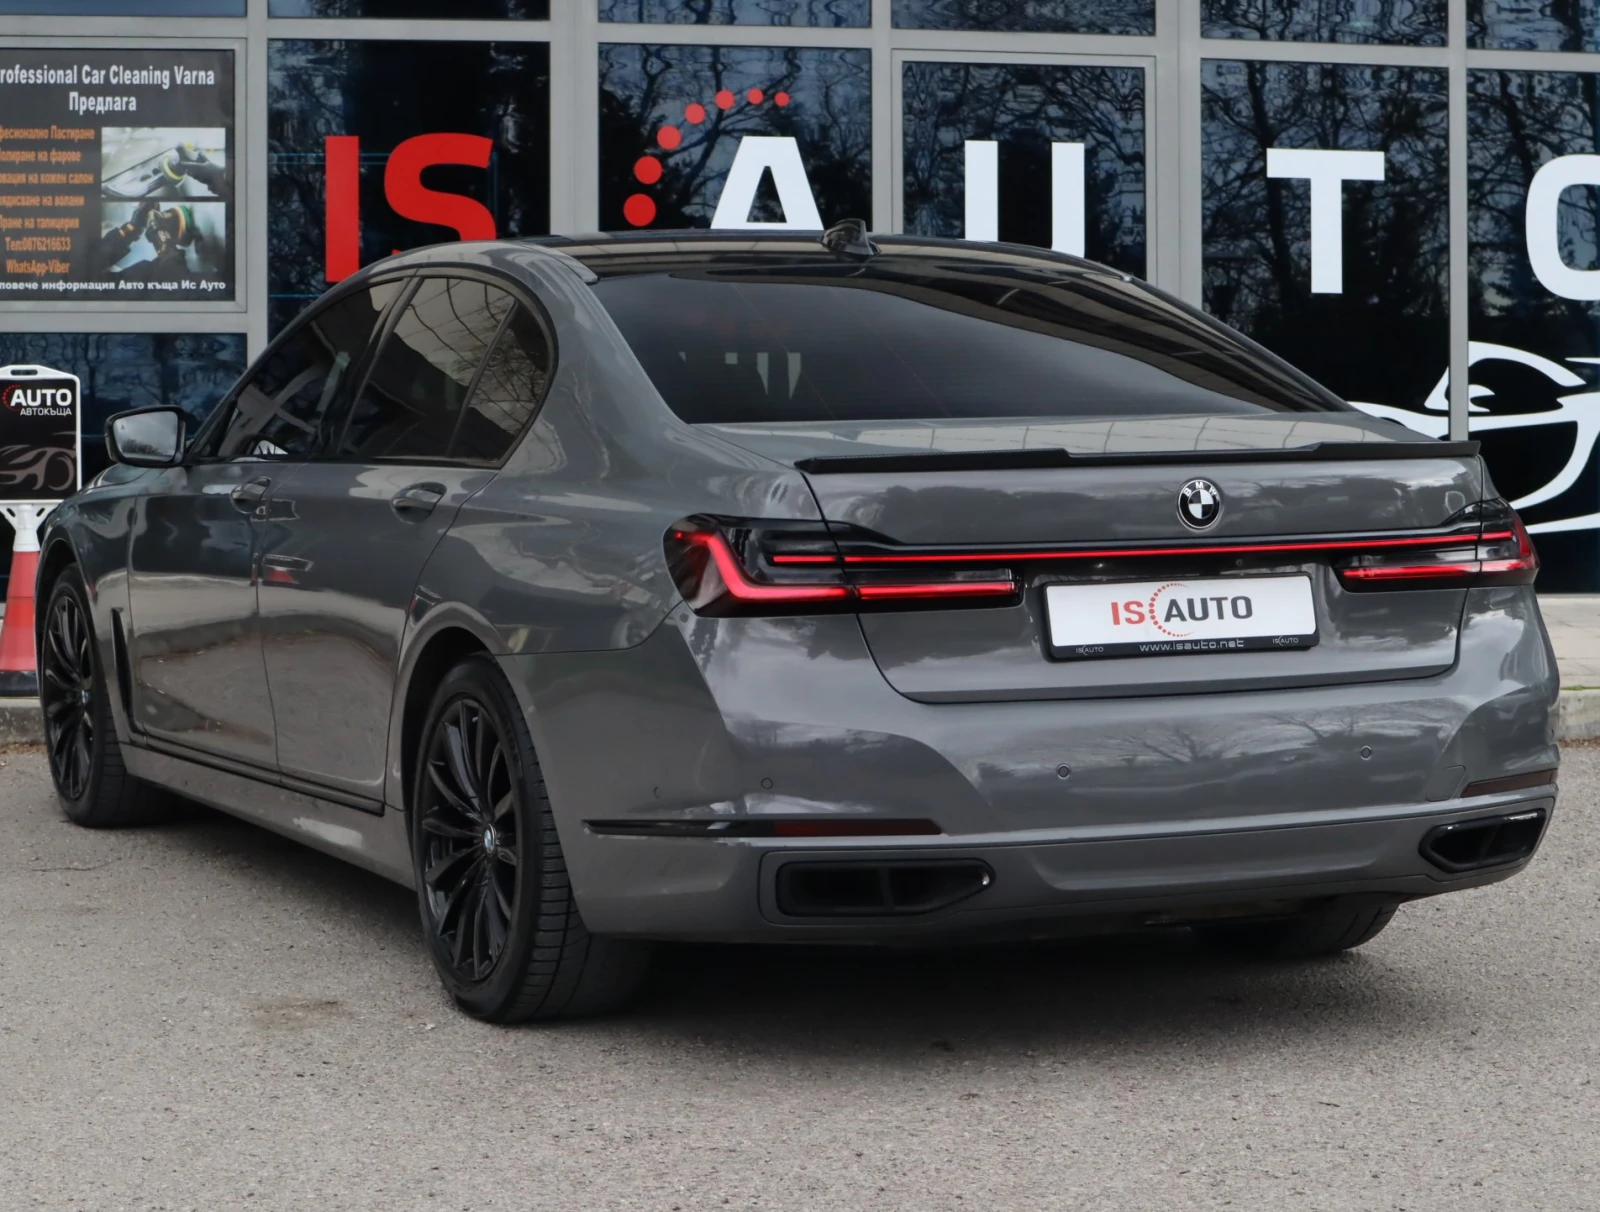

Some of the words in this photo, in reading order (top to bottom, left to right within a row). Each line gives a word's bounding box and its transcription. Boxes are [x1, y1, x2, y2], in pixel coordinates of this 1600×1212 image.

[81, 65, 105, 85] Car
[109, 65, 170, 89] Cleaning
[174, 65, 215, 85] Varna
[69, 92, 137, 115] Предлага
[0, 148, 36, 165] олиране
[37, 151, 48, 162] на
[28, 173, 39, 184] на
[325, 132, 498, 283] IS
[24, 218, 35, 229] на
[41, 280, 115, 292] информация
[118, 281, 144, 290] Авто
[147, 281, 178, 291] къща
[181, 281, 197, 290] Ис
[199, 281, 226, 292] Ауто
[10, 388, 72, 407] AUTO
[20, 407, 72, 416] АВТОКЪЩА
[1183, 481, 1218, 497] BMW
[1111, 600, 1146, 626] IS
[1164, 595, 1253, 623] AUTO
[1140, 639, 1244, 652] www.isauto.net
